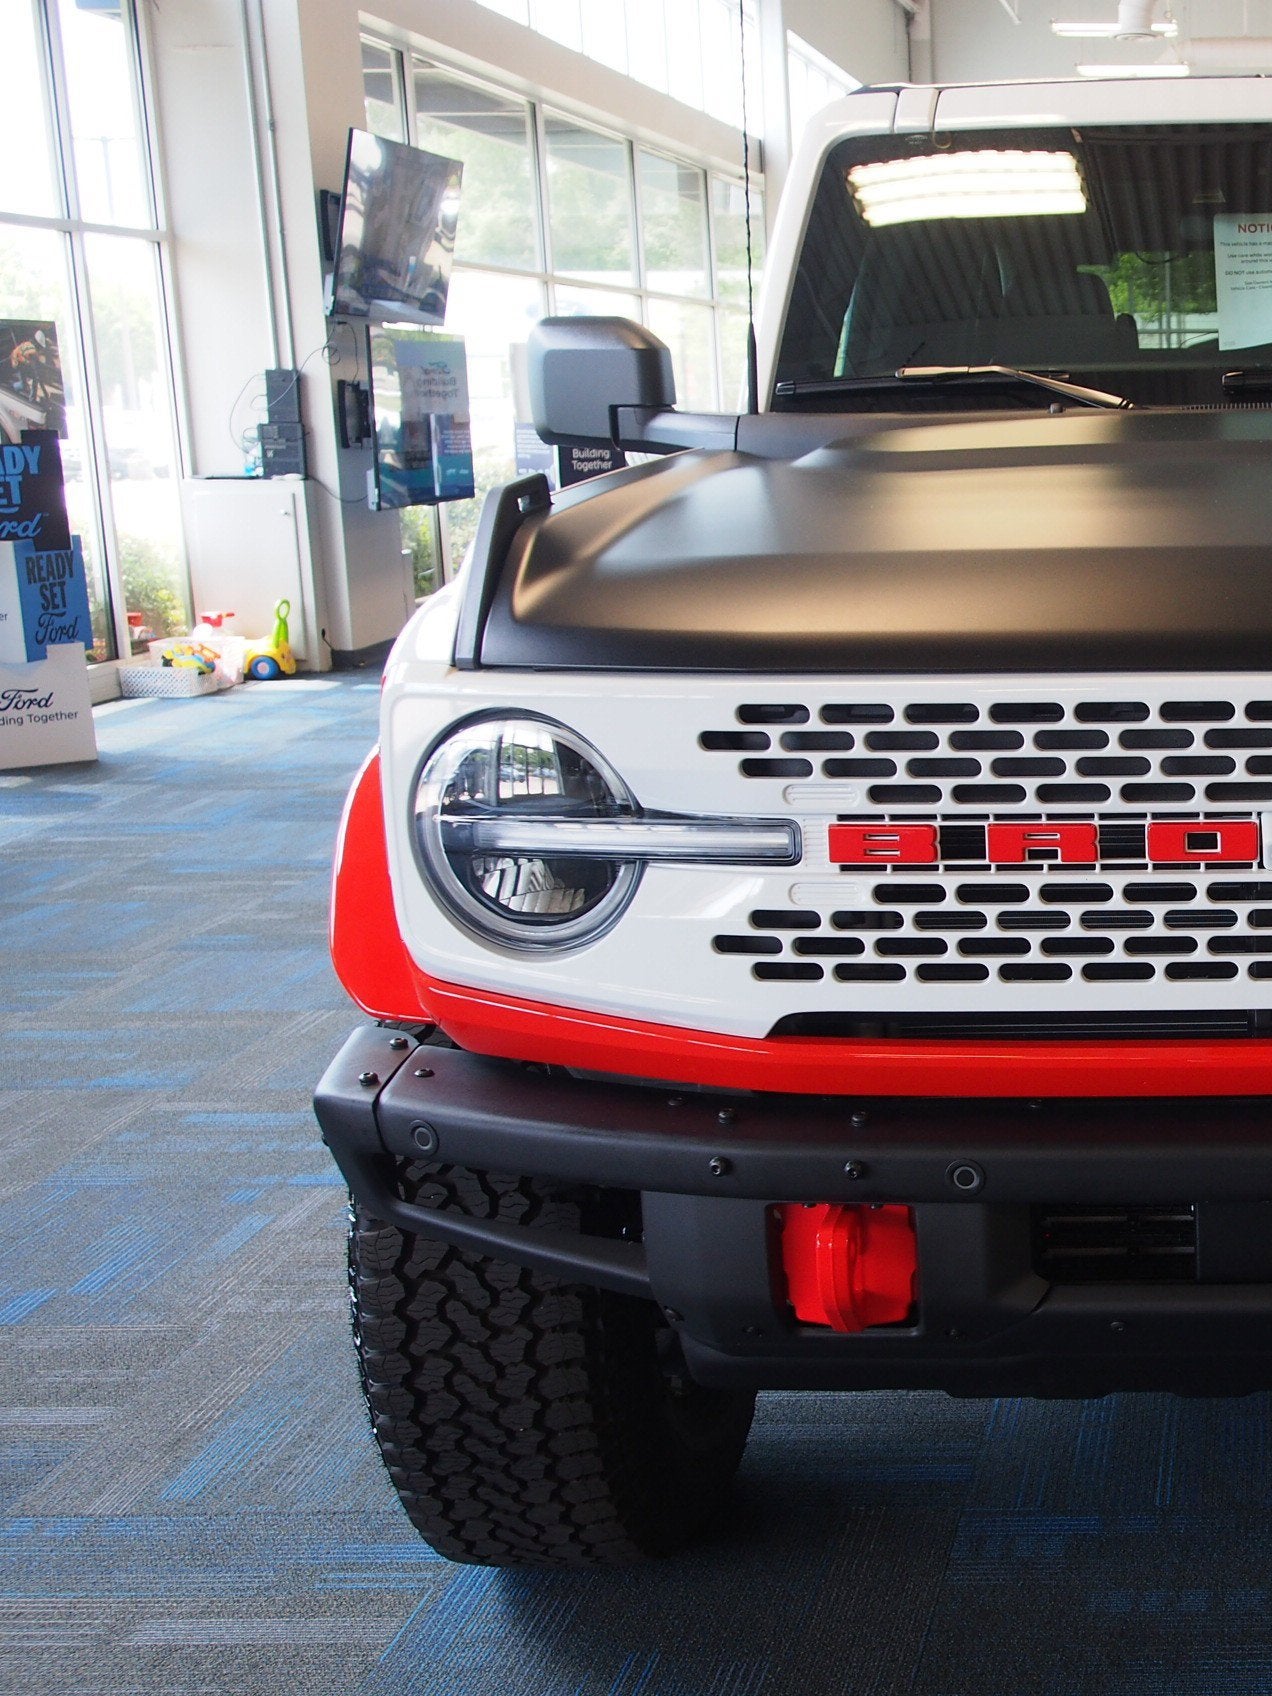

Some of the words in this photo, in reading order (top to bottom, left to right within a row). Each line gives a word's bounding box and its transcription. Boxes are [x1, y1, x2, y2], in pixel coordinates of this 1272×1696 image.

[572, 448, 610, 459] Building
[572, 460, 612, 472] Together
[25, 550, 74, 585] READY
[39, 581, 66, 611] SET
[35, 611, 79, 645] Ford
[0, 688, 54, 711] Ford
[26, 711, 79, 724] Together
